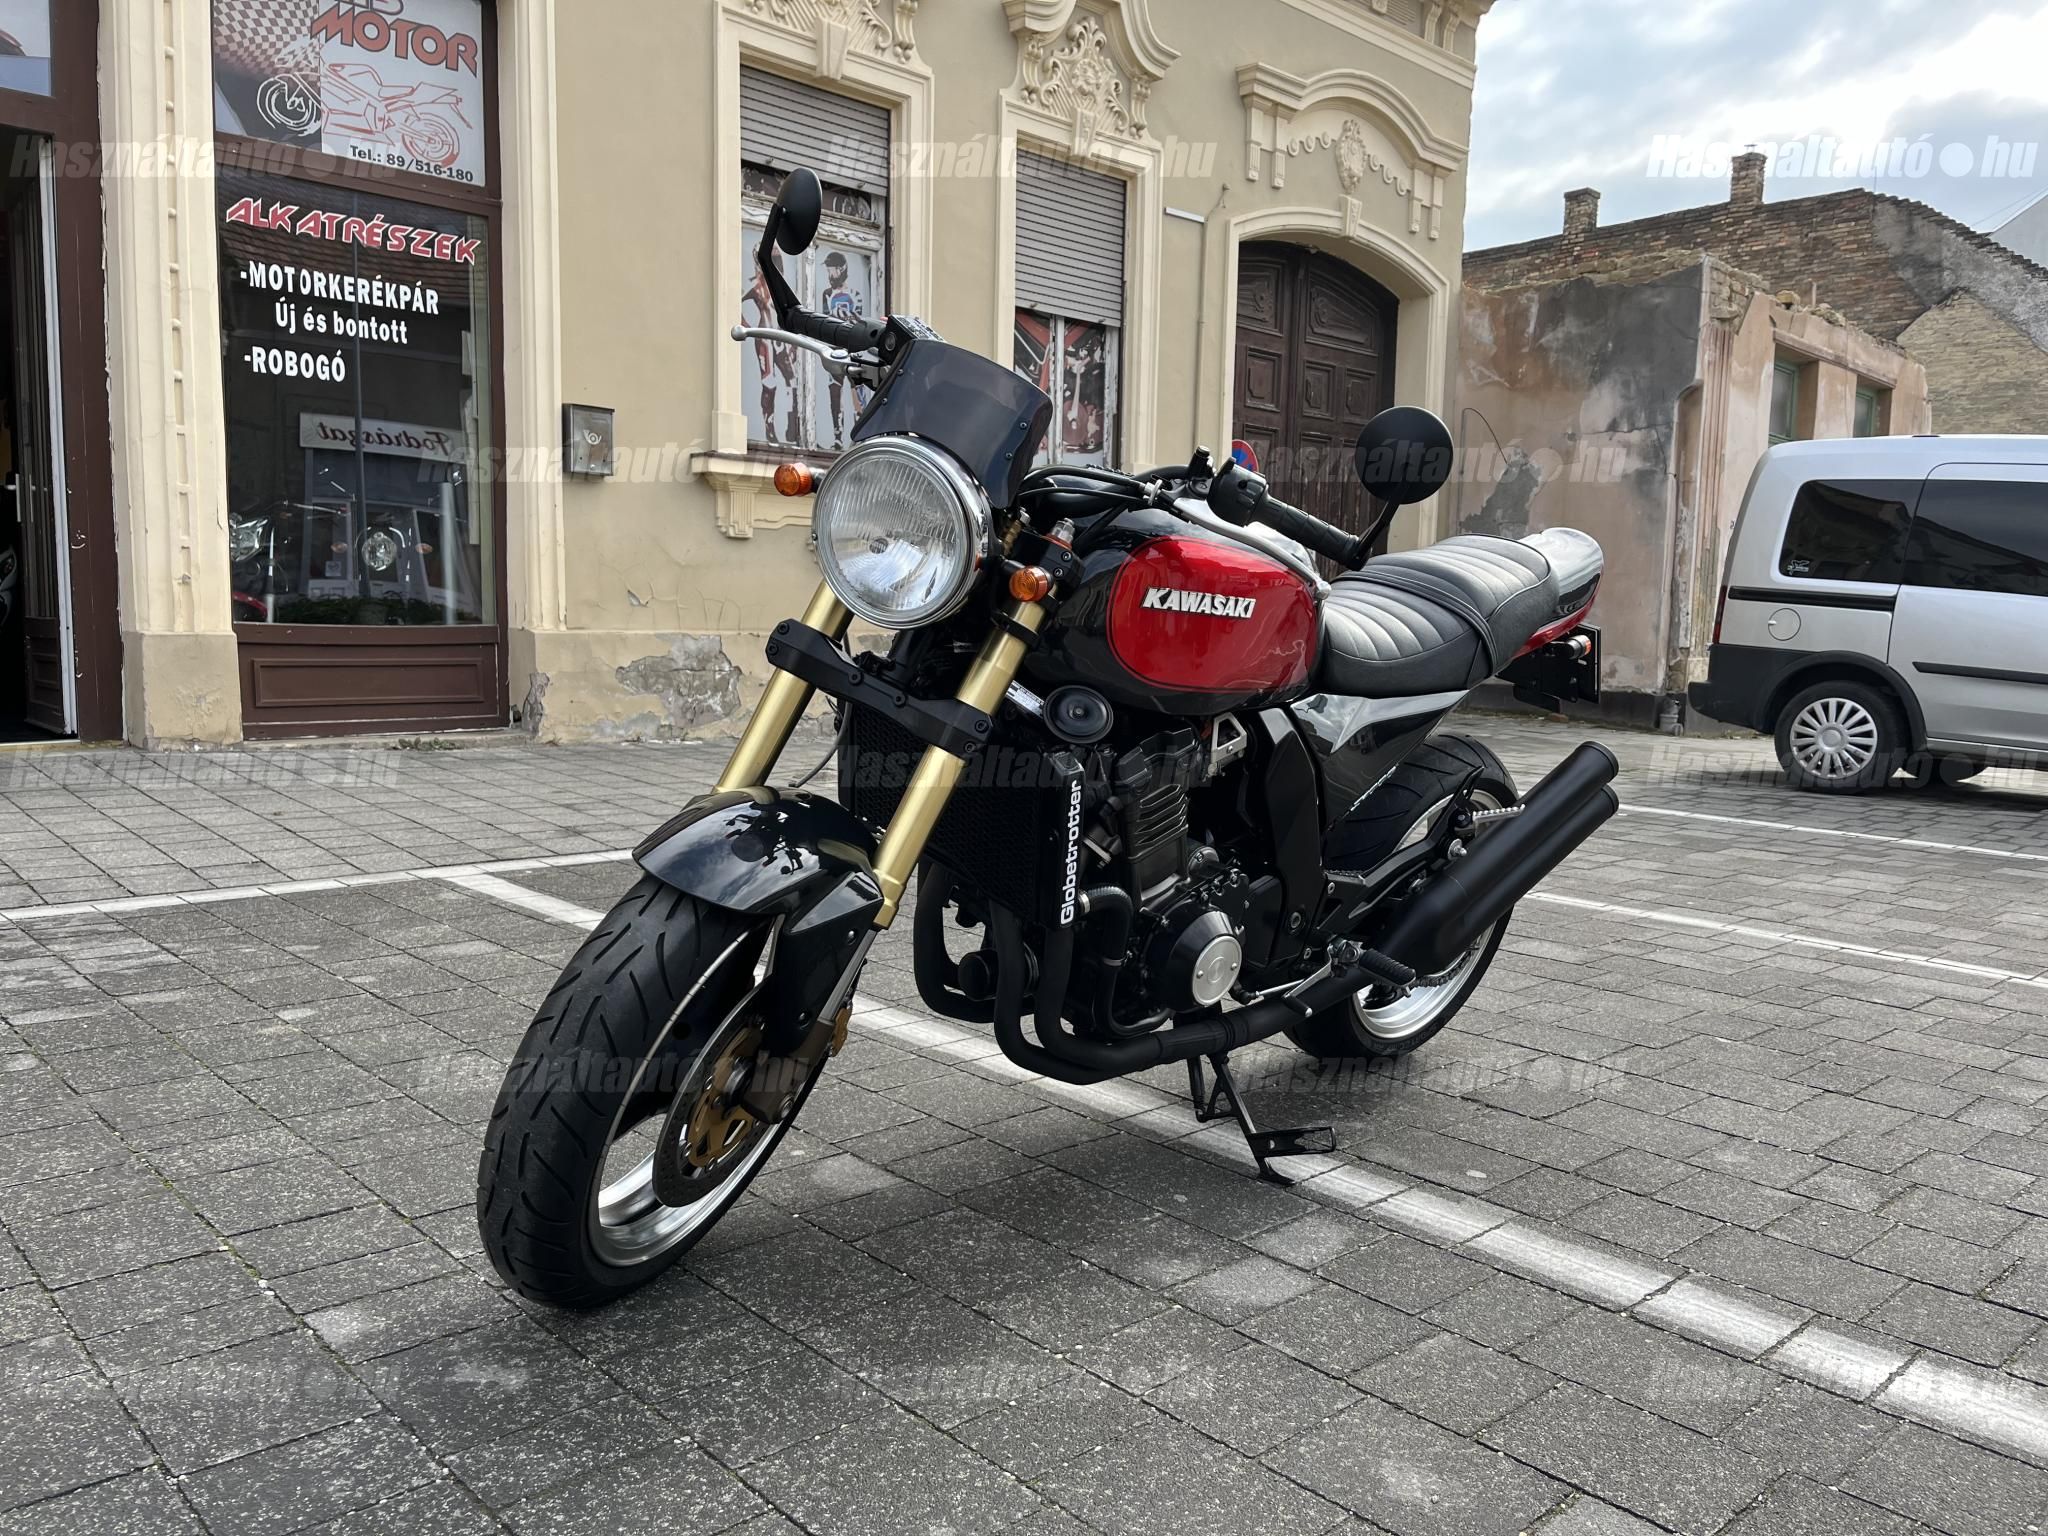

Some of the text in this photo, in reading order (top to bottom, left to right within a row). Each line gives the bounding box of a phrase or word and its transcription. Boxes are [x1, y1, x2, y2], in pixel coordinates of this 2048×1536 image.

[310, 1, 478, 78] MOTOR
[350, 145, 473, 182] Tel.: 89/516-180
[226, 197, 481, 265] ALKATRÉSZEK
[240, 261, 439, 315] -MOTORKERÉKPÁR
[275, 297, 408, 344] Új és bontott
[244, 346, 346, 382] -ROBOGÓ
[1142, 587, 1256, 619] KAWASAKI
[1060, 780, 1082, 925] Globetrotter
